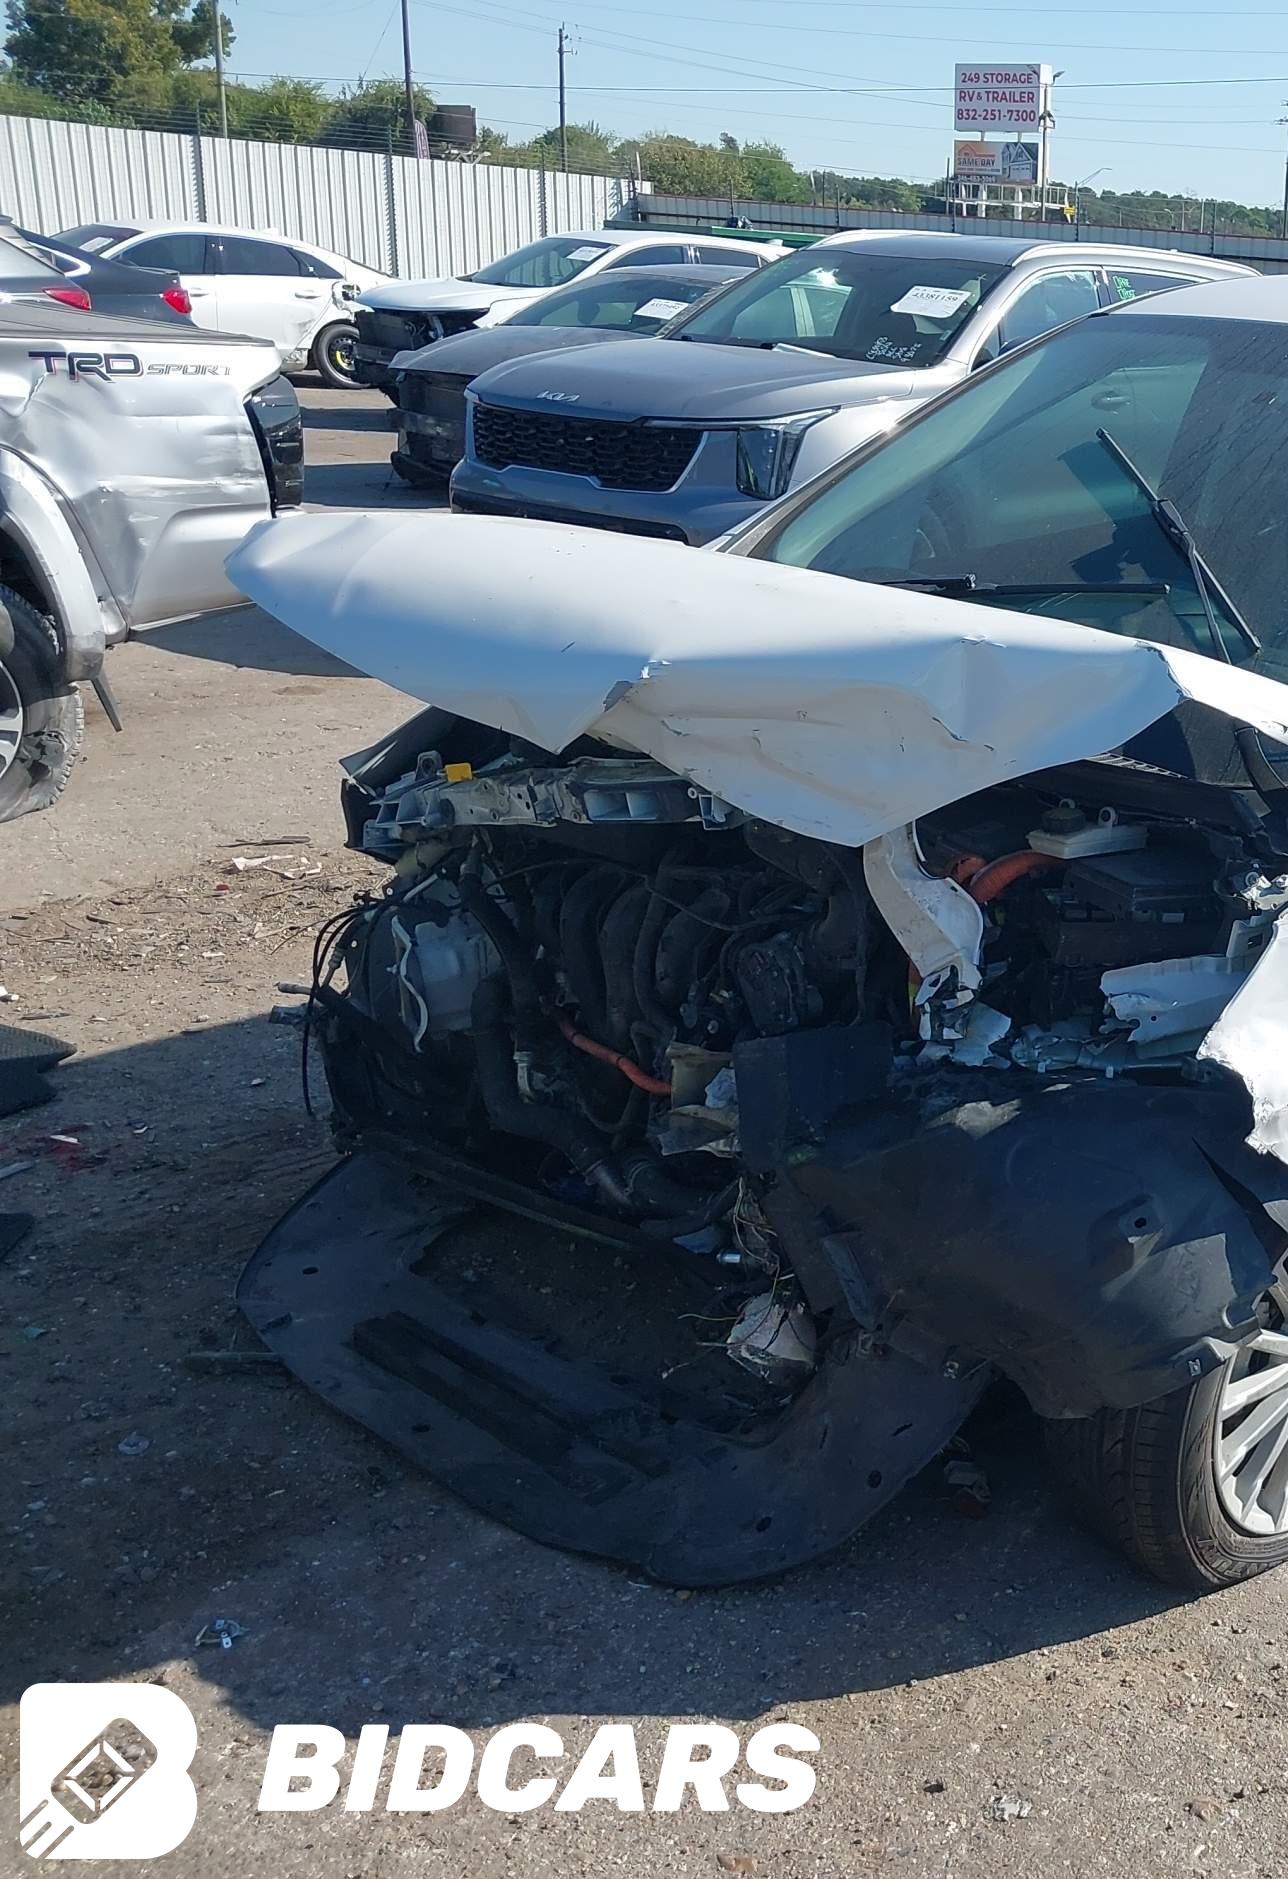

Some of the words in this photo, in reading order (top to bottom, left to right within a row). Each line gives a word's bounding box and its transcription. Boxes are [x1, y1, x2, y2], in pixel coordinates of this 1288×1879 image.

[961, 72, 981, 84] 249
[982, 72, 1033, 84] STORAGE
[958, 90, 977, 103] RV
[976, 93, 983, 101] &
[984, 90, 1035, 104] TRAILER
[957, 108, 1036, 123] 832-251-7300
[28, 351, 144, 384] TRD
[535, 389, 580, 402] KIA
